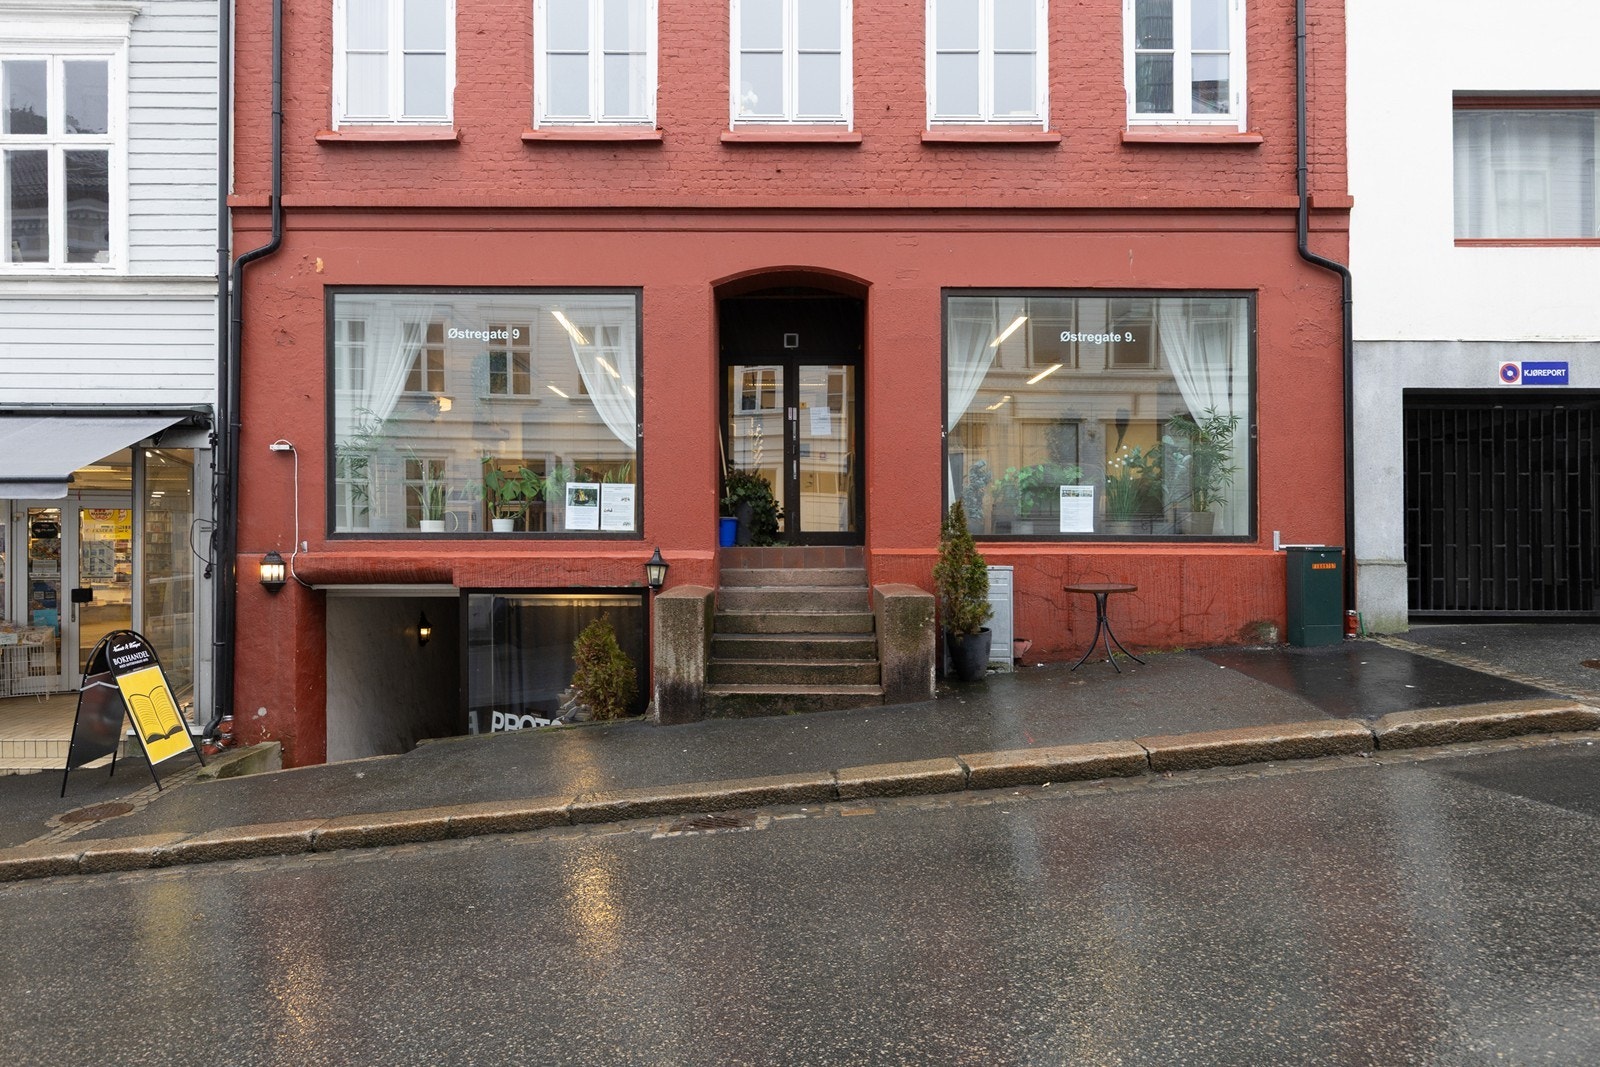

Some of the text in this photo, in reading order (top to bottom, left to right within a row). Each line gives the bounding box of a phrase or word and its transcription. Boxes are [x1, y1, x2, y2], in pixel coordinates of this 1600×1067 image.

[448, 328, 520, 342] Østregate 9
[1060, 331, 1136, 345] Østregate 9.
[1524, 369, 1566, 377] KJØREPORT
[113, 650, 150, 666] BOKHANDEL
[491, 711, 563, 733] PROT
